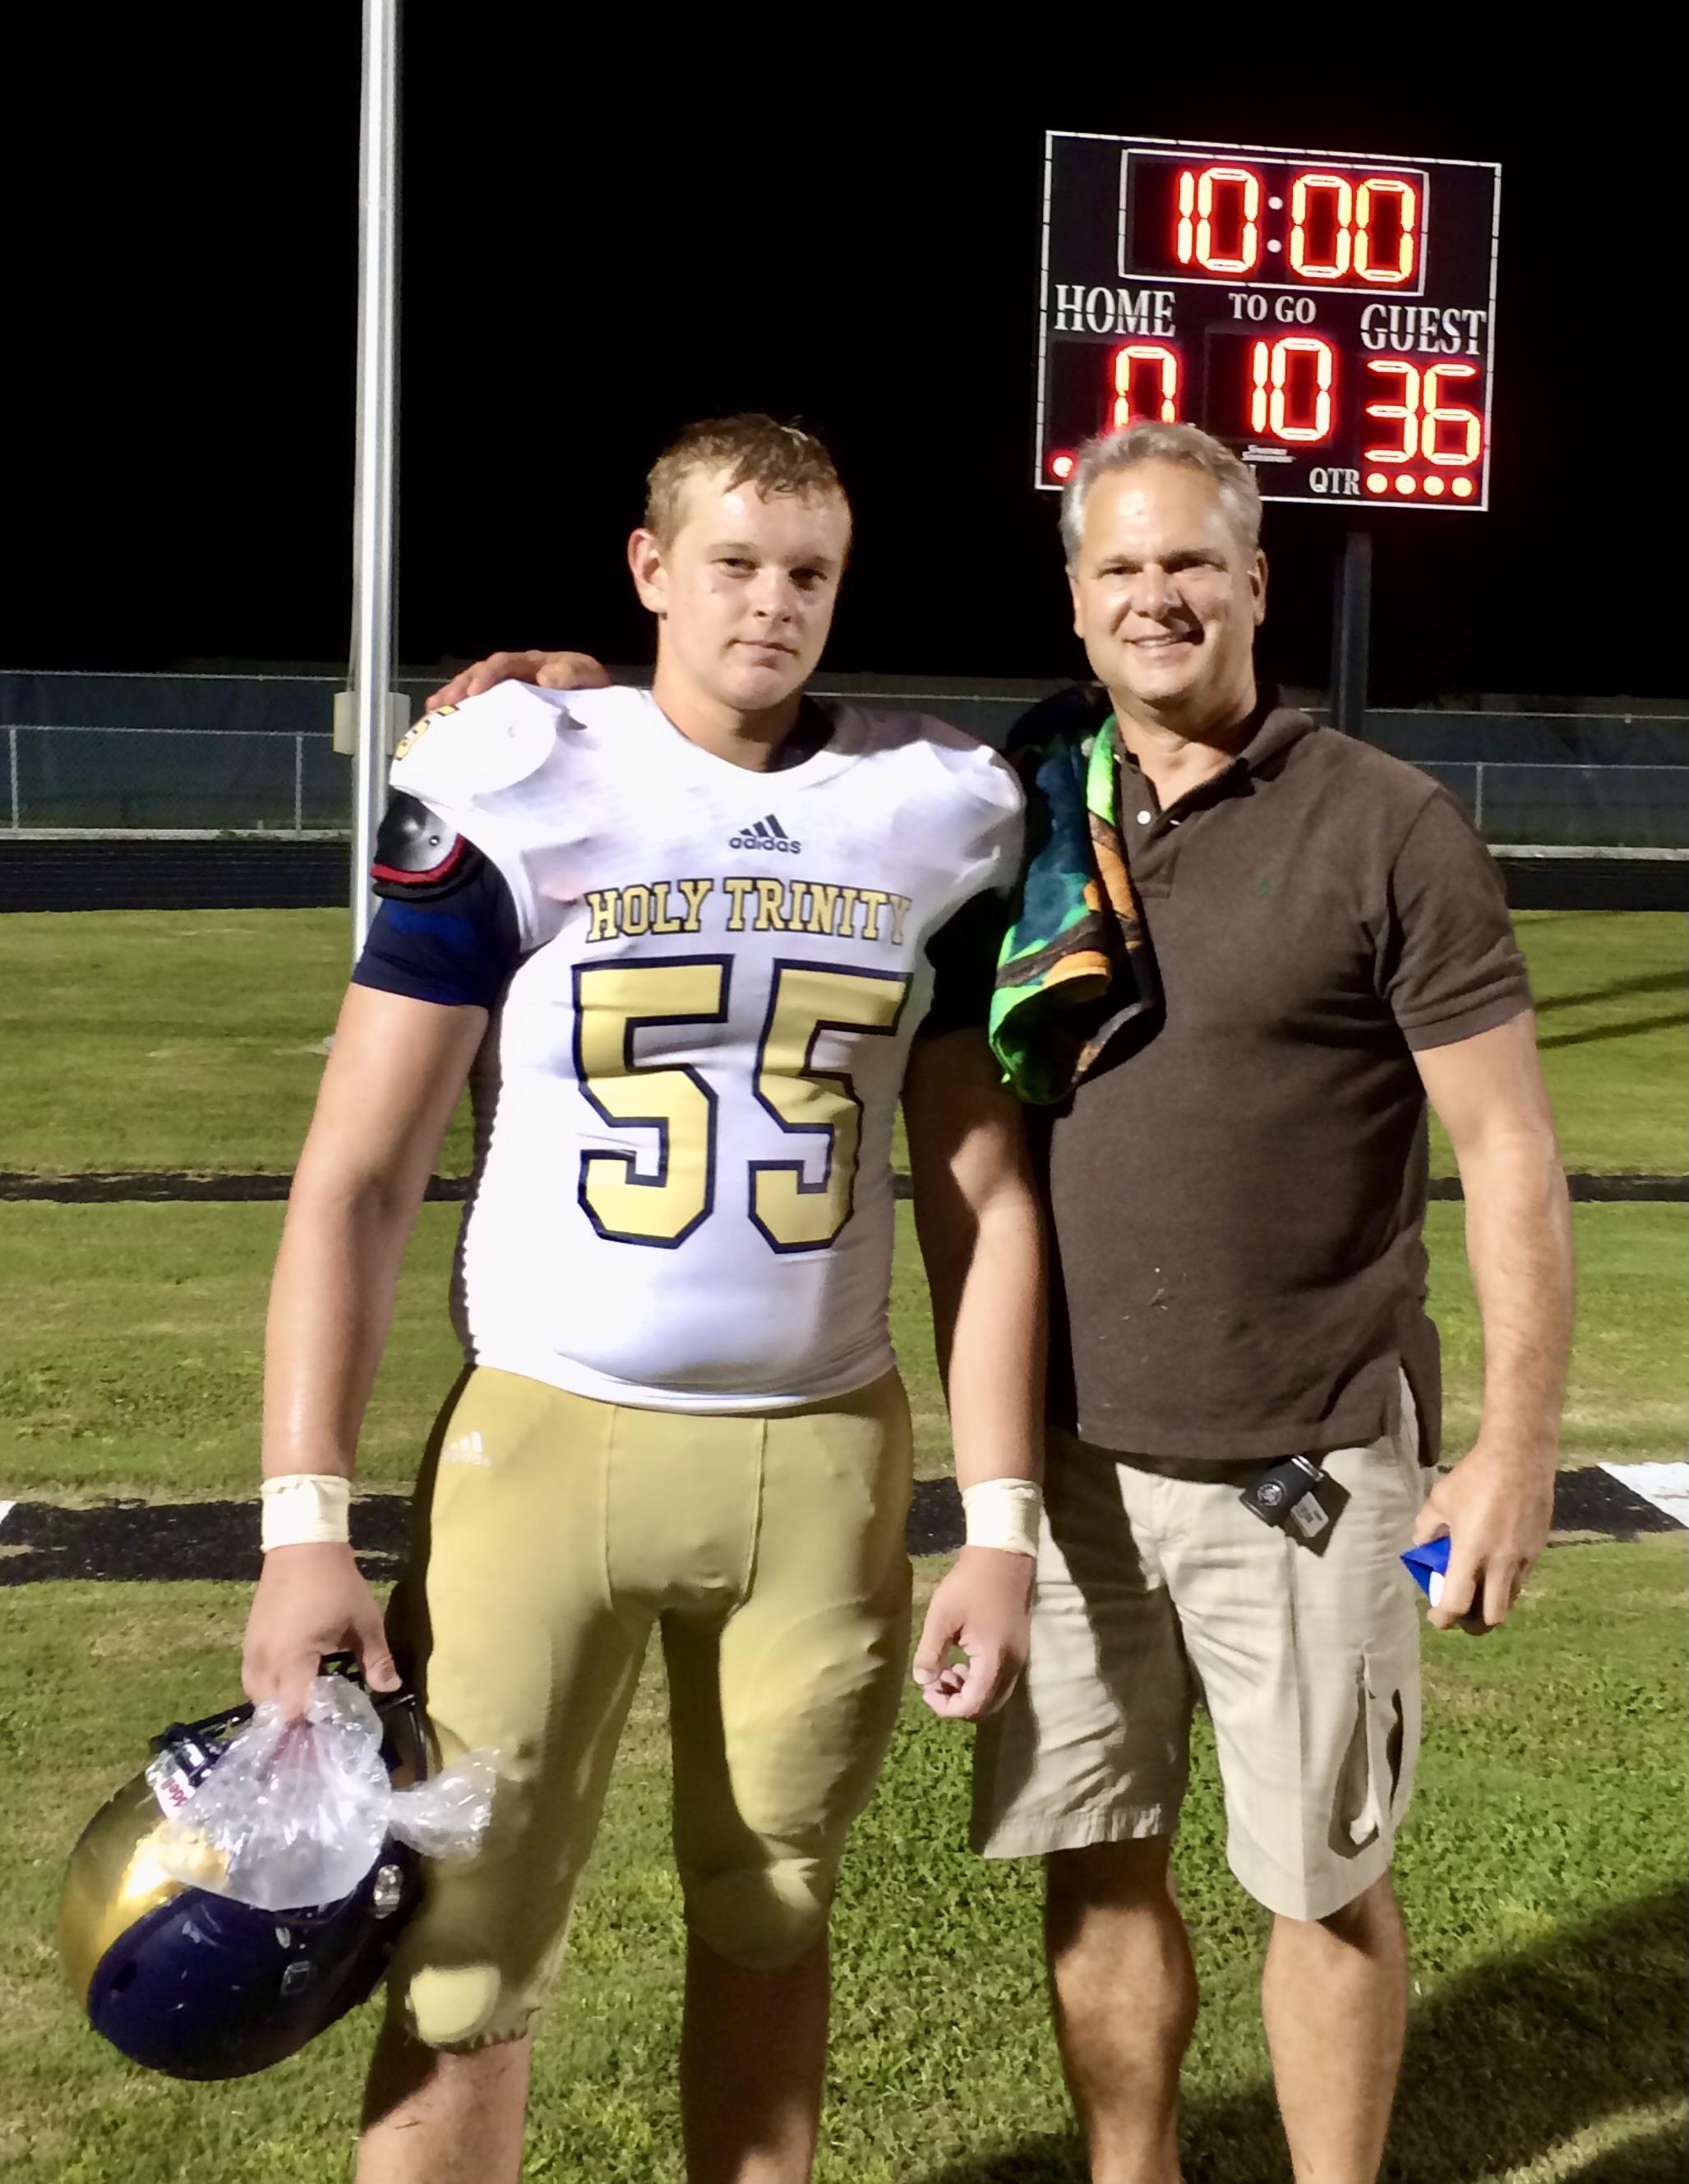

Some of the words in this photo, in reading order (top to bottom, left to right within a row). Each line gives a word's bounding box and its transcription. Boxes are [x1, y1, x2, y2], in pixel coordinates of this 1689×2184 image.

[1177, 167, 1415, 283] 10:00
[1054, 284, 1176, 337] HOME
[1229, 293, 1267, 320] TO
[1275, 295, 1317, 324] GO
[1360, 303, 1487, 355] GUEST
[1252, 337, 1332, 441] 10
[1364, 360, 1480, 466] 36
[1308, 467, 1361, 495] QTR
[728, 835, 802, 855] adidas
[584, 878, 714, 943] HOLY
[723, 876, 913, 945] TRINITY
[571, 954, 914, 1254] 55
